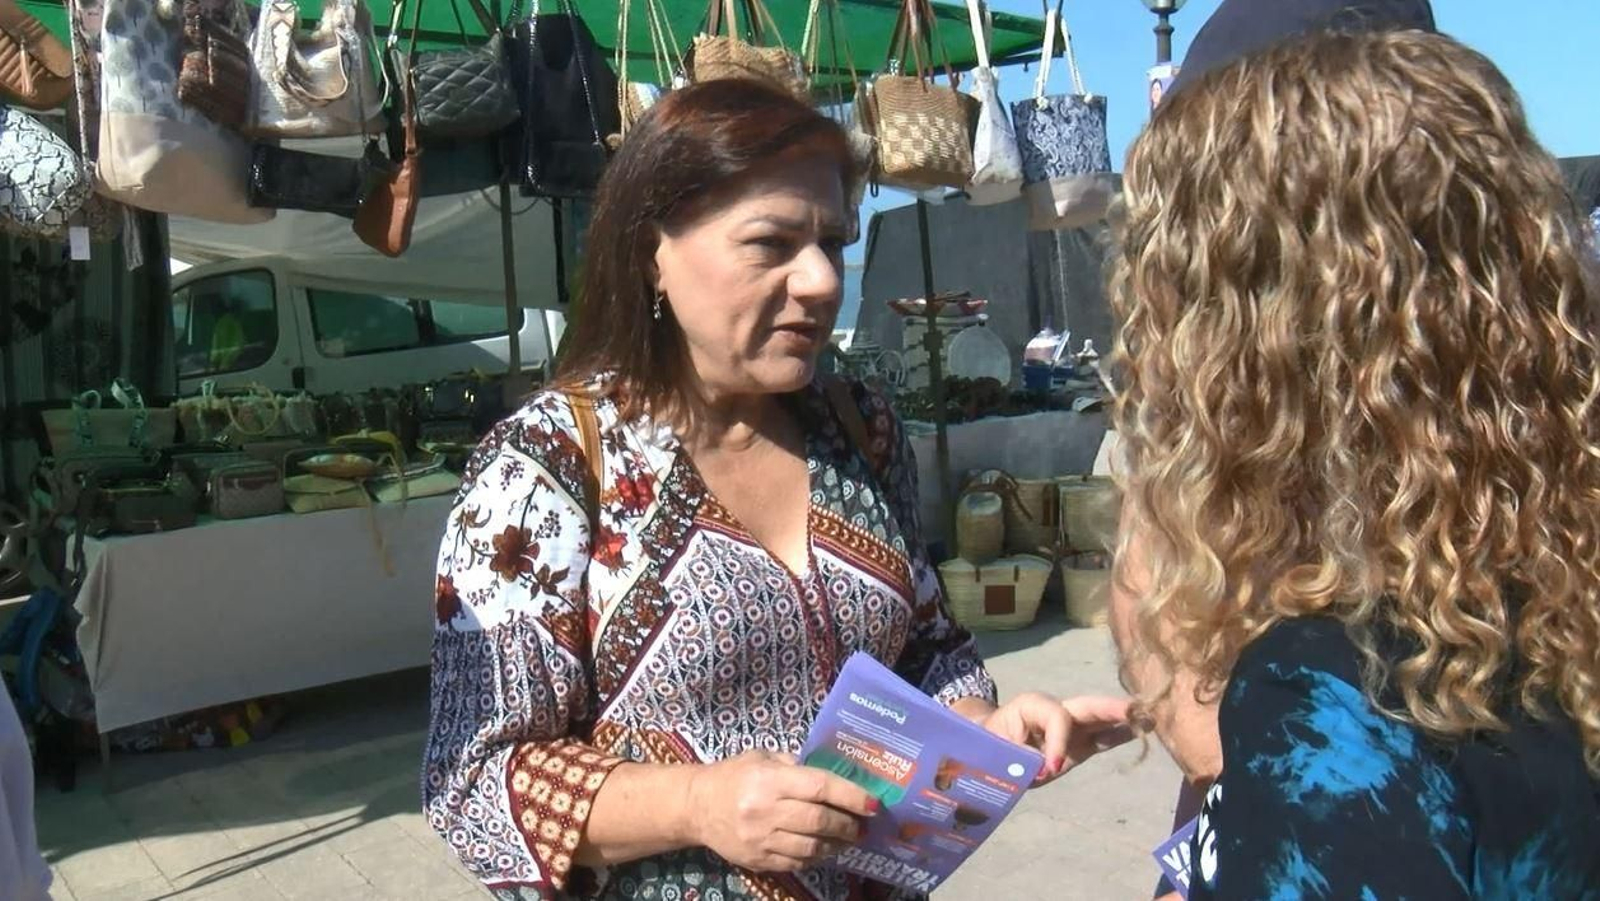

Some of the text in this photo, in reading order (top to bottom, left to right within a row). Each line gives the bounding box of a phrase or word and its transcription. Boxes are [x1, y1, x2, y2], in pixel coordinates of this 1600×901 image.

[849, 692, 906, 725] Podemos
[837, 741, 907, 780] Ascensión
[882, 750, 912, 772] Ruiz
